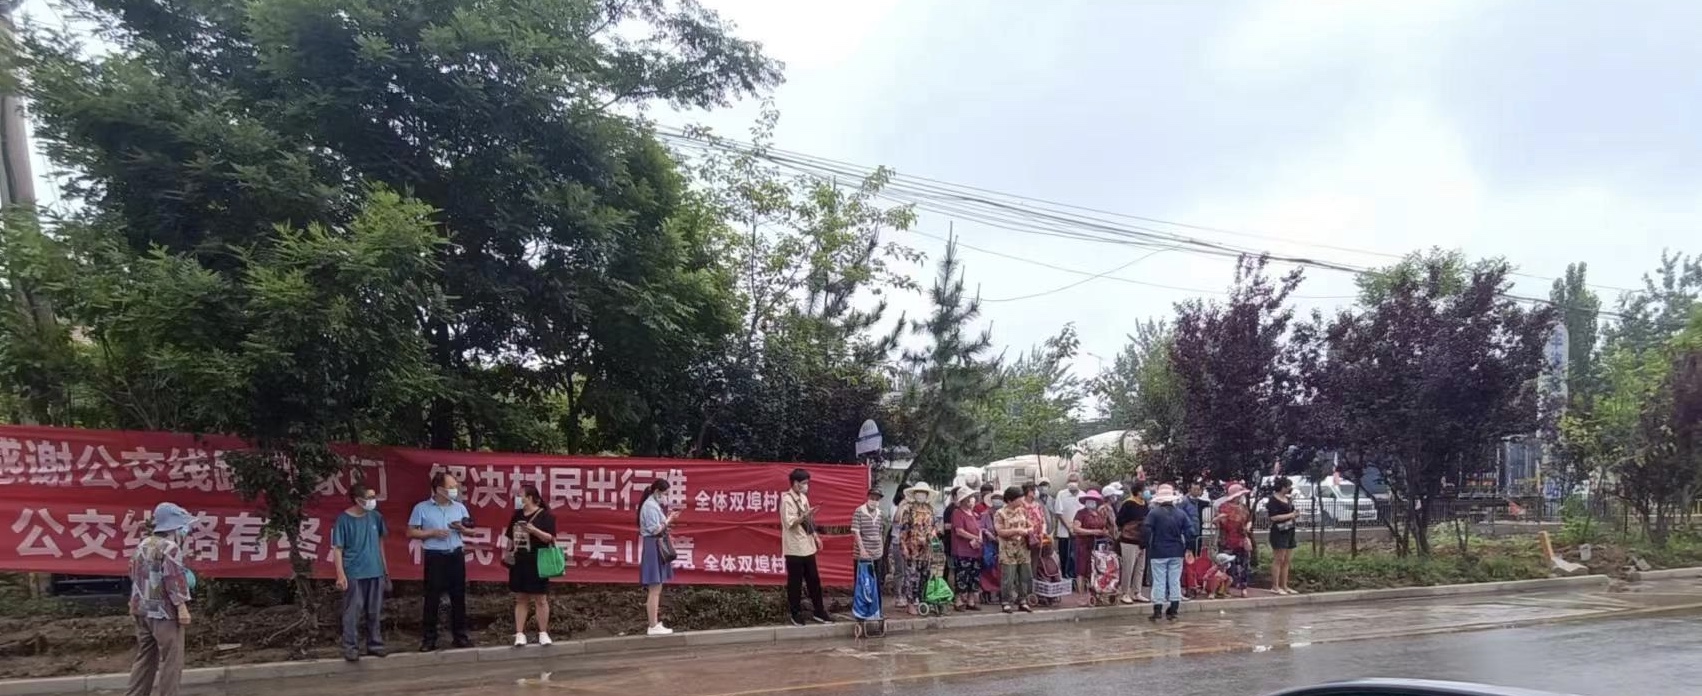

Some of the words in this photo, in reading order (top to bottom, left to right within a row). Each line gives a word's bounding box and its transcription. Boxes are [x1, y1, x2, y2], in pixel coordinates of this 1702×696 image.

[694, 490, 790, 512] 全体双埠村
[12, 507, 336, 563] 公交路有终
